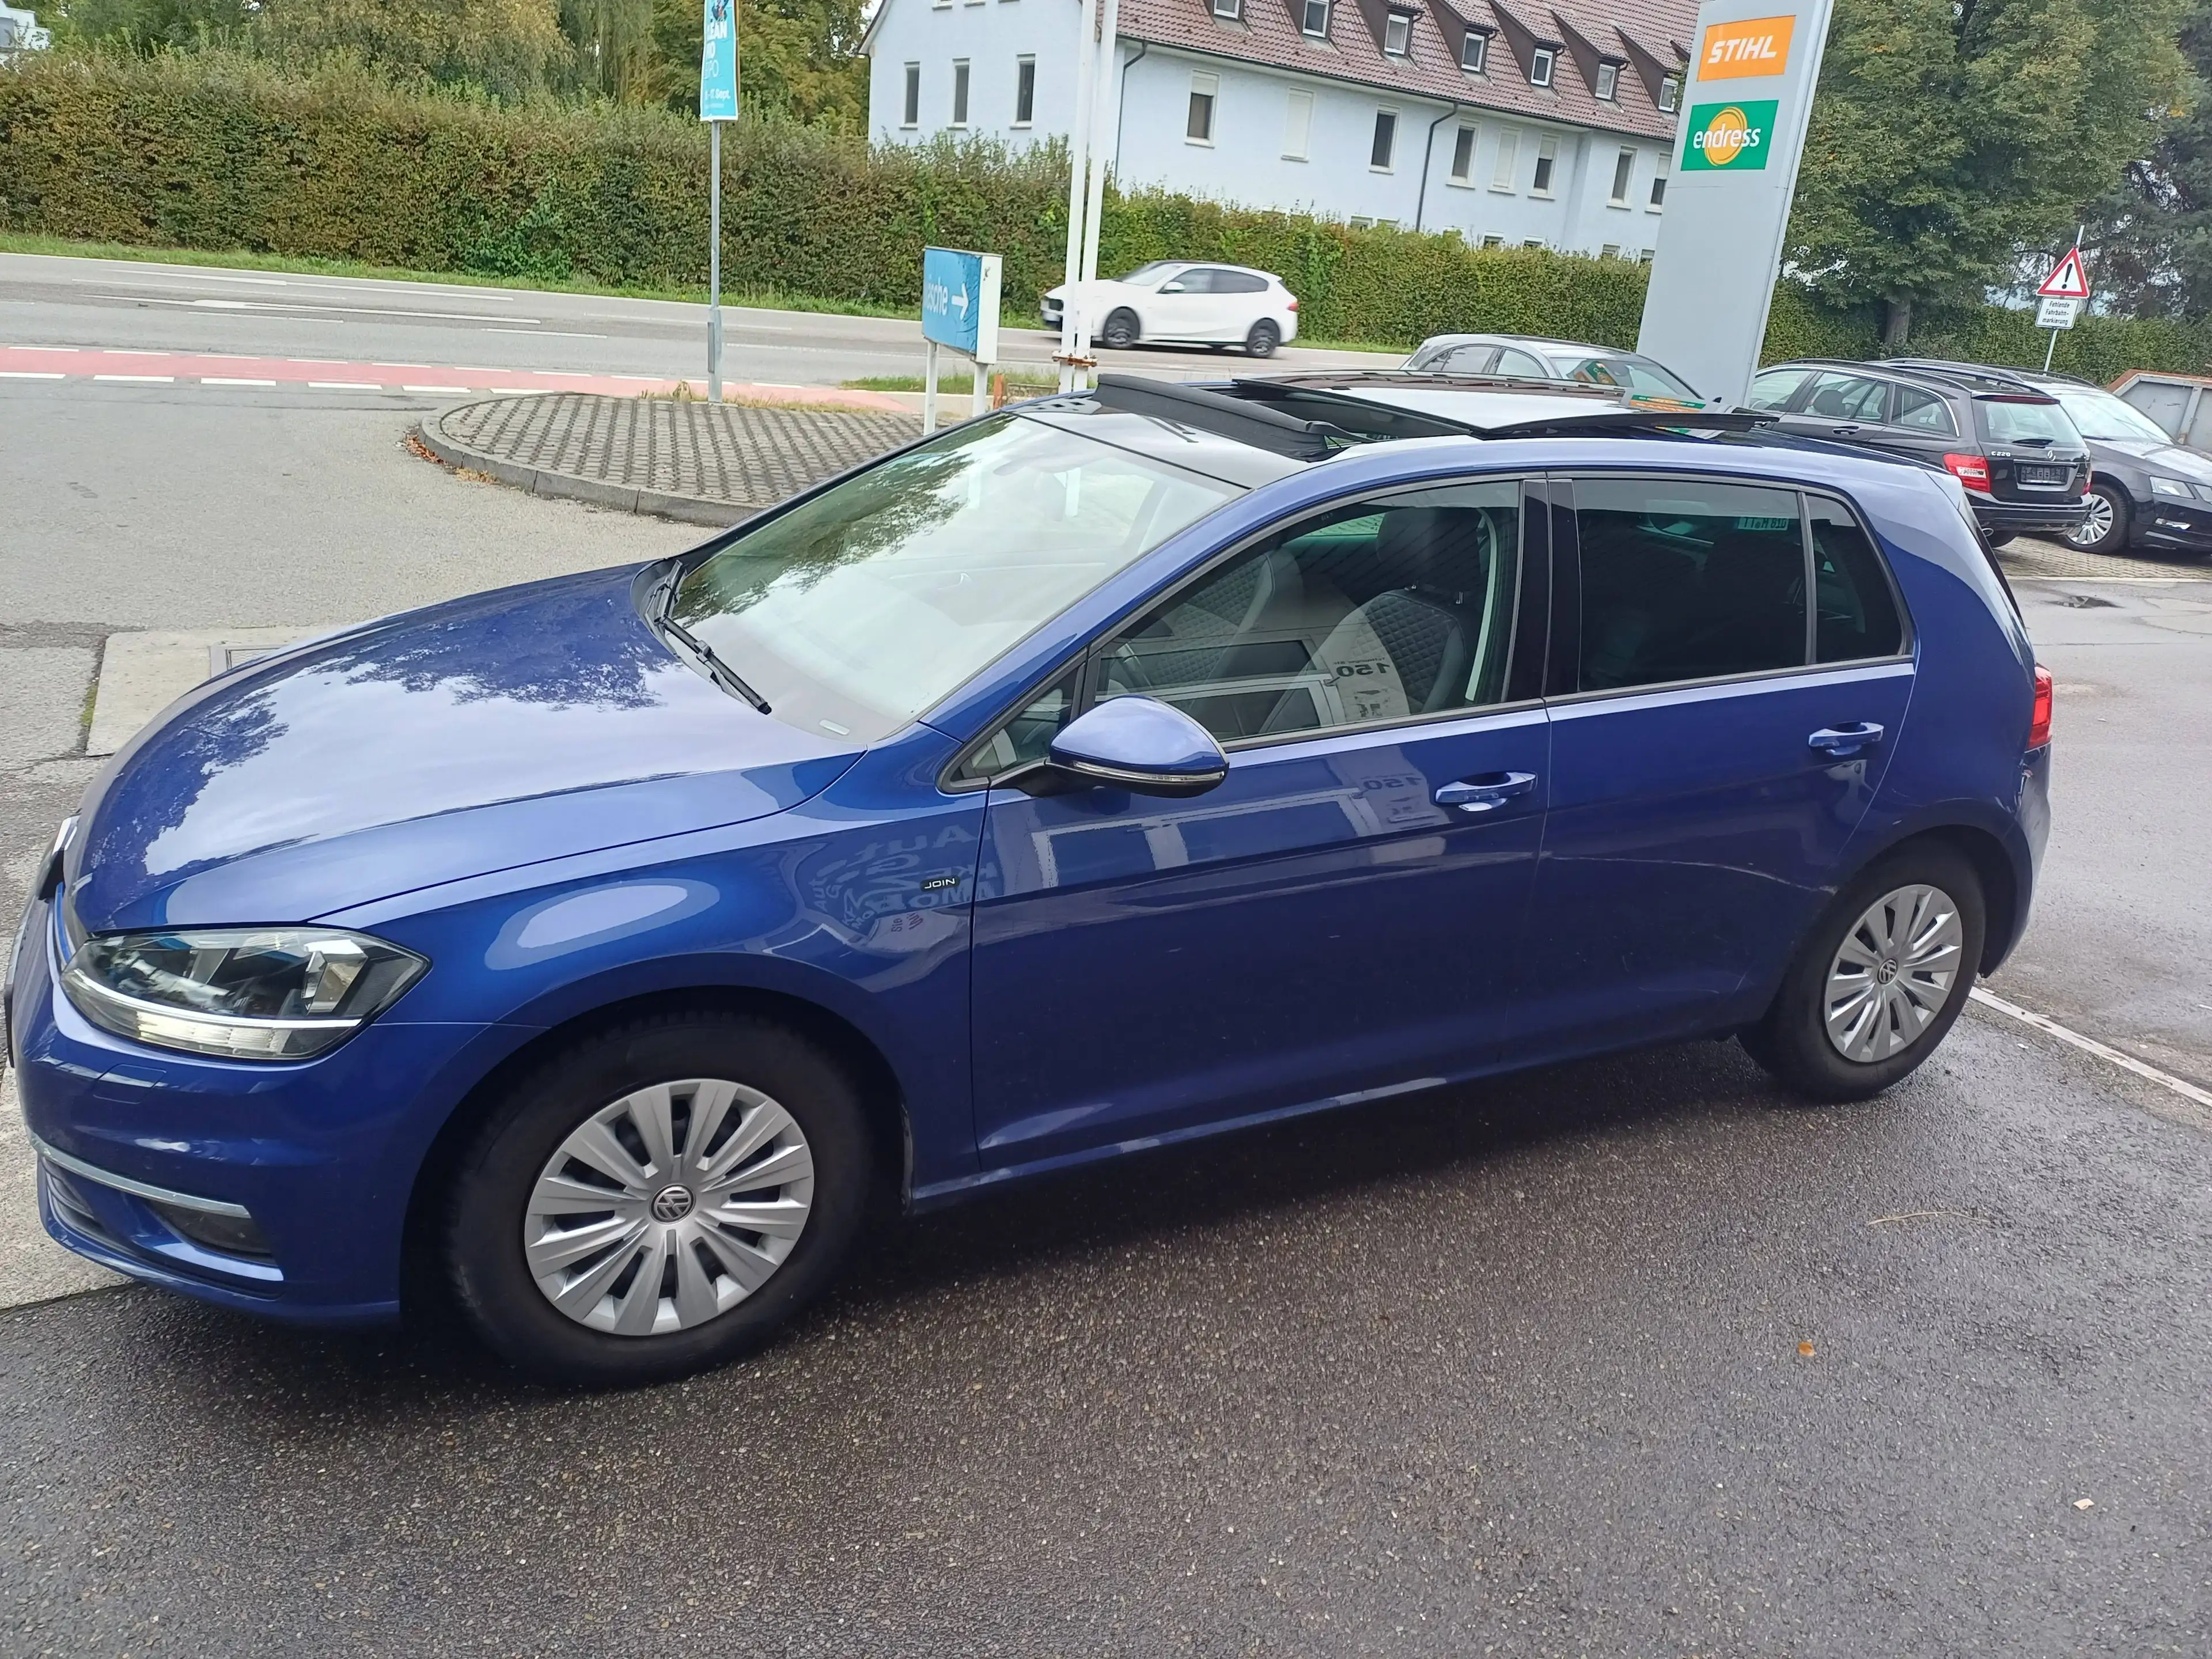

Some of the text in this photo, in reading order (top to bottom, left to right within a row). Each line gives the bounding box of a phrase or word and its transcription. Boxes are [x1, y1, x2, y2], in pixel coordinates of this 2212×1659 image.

[1707, 35, 1777, 64] STIHL
[1693, 123, 1761, 149] endress
[2042, 318, 2068, 326] markierung
[924, 877, 955, 889] JOIN
